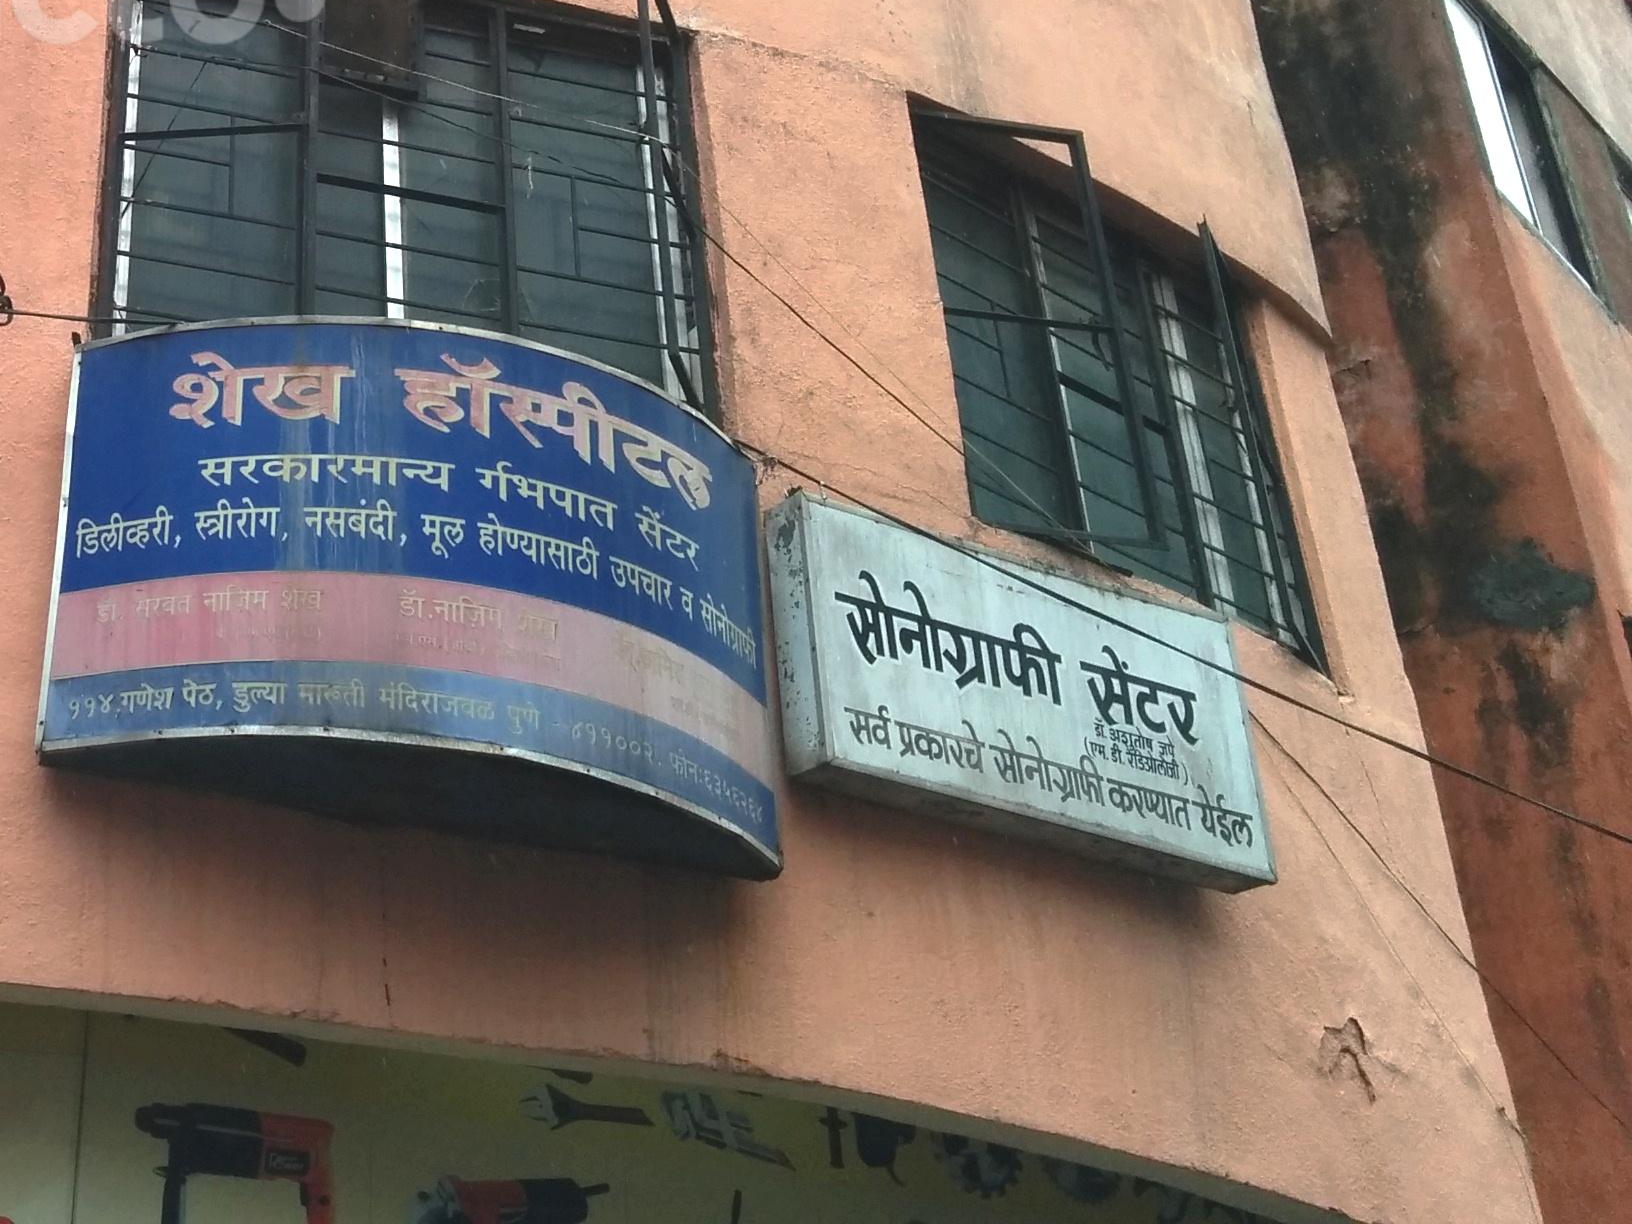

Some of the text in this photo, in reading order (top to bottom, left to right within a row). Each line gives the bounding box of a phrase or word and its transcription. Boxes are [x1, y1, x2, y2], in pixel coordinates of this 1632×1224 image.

[169, 352, 713, 510] शेख हॉस्पीटल
[198, 455, 455, 492] सरकारमान्य
[635, 505, 699, 571] सेंटर
[421, 513, 465, 559] मूल
[478, 513, 600, 580] होण्यासाठी
[609, 555, 673, 610] उपचार
[680, 587, 694, 622] व
[700, 592, 757, 669] सोनोग्राफी
[834, 569, 1063, 706] सोनोग्राफी
[1080, 645, 1200, 746] सेंटर
[843, 705, 1254, 849] सर्व प्रकारचे सोनोग्राफी करण्यात येईल
